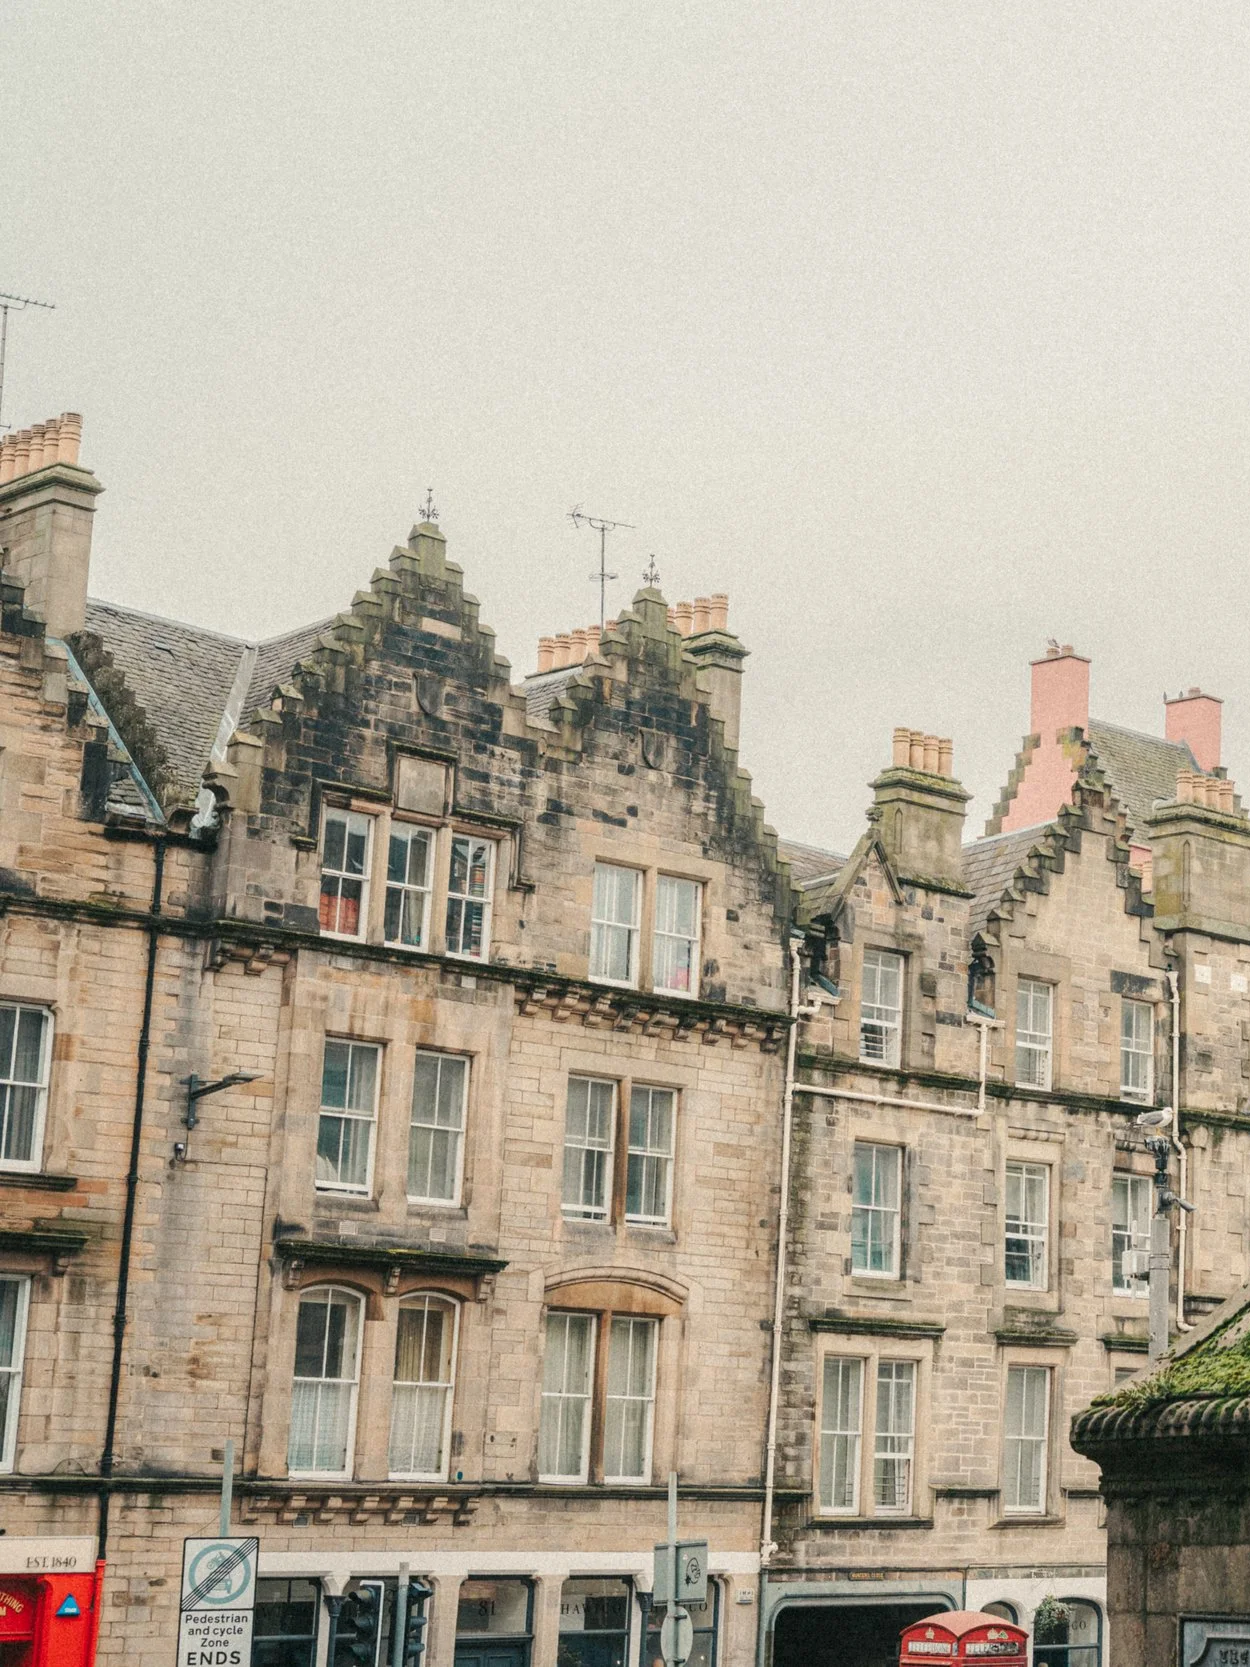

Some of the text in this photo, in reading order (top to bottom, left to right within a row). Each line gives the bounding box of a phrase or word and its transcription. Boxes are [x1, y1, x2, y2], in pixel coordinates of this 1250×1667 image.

[51, 1556, 77, 1568] 1840
[186, 1614, 248, 1623] Pedestrian
[188, 1626, 243, 1636] and cycle
[201, 1638, 229, 1647] Zone
[187, 1651, 241, 1665] ENDS
